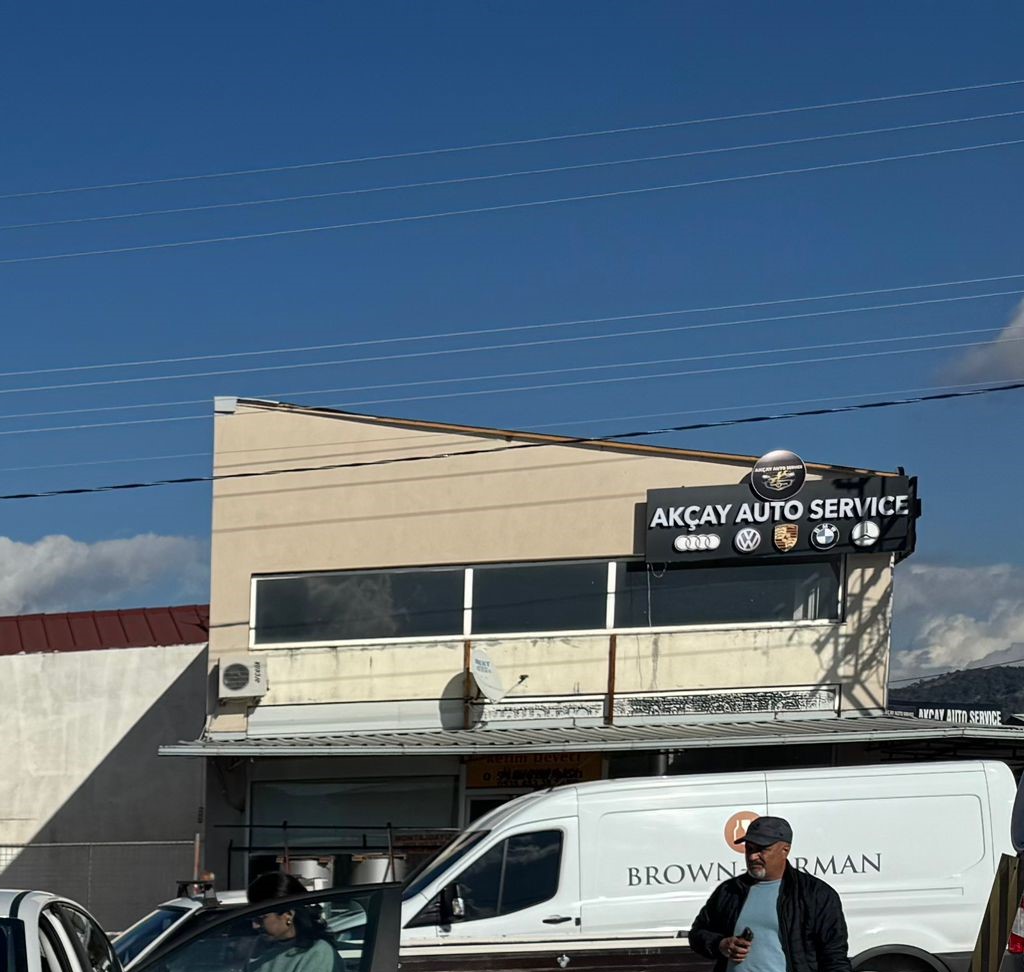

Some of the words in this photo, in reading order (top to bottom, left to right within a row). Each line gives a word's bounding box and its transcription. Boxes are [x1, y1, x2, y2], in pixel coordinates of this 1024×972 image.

[650, 503, 733, 531] AKÇAY
[735, 501, 804, 523] AUTO
[810, 495, 909, 519] SERVICE
[970, 711, 1002, 725] SERVICE
[628, 853, 881, 886] BROWN-RMAN
